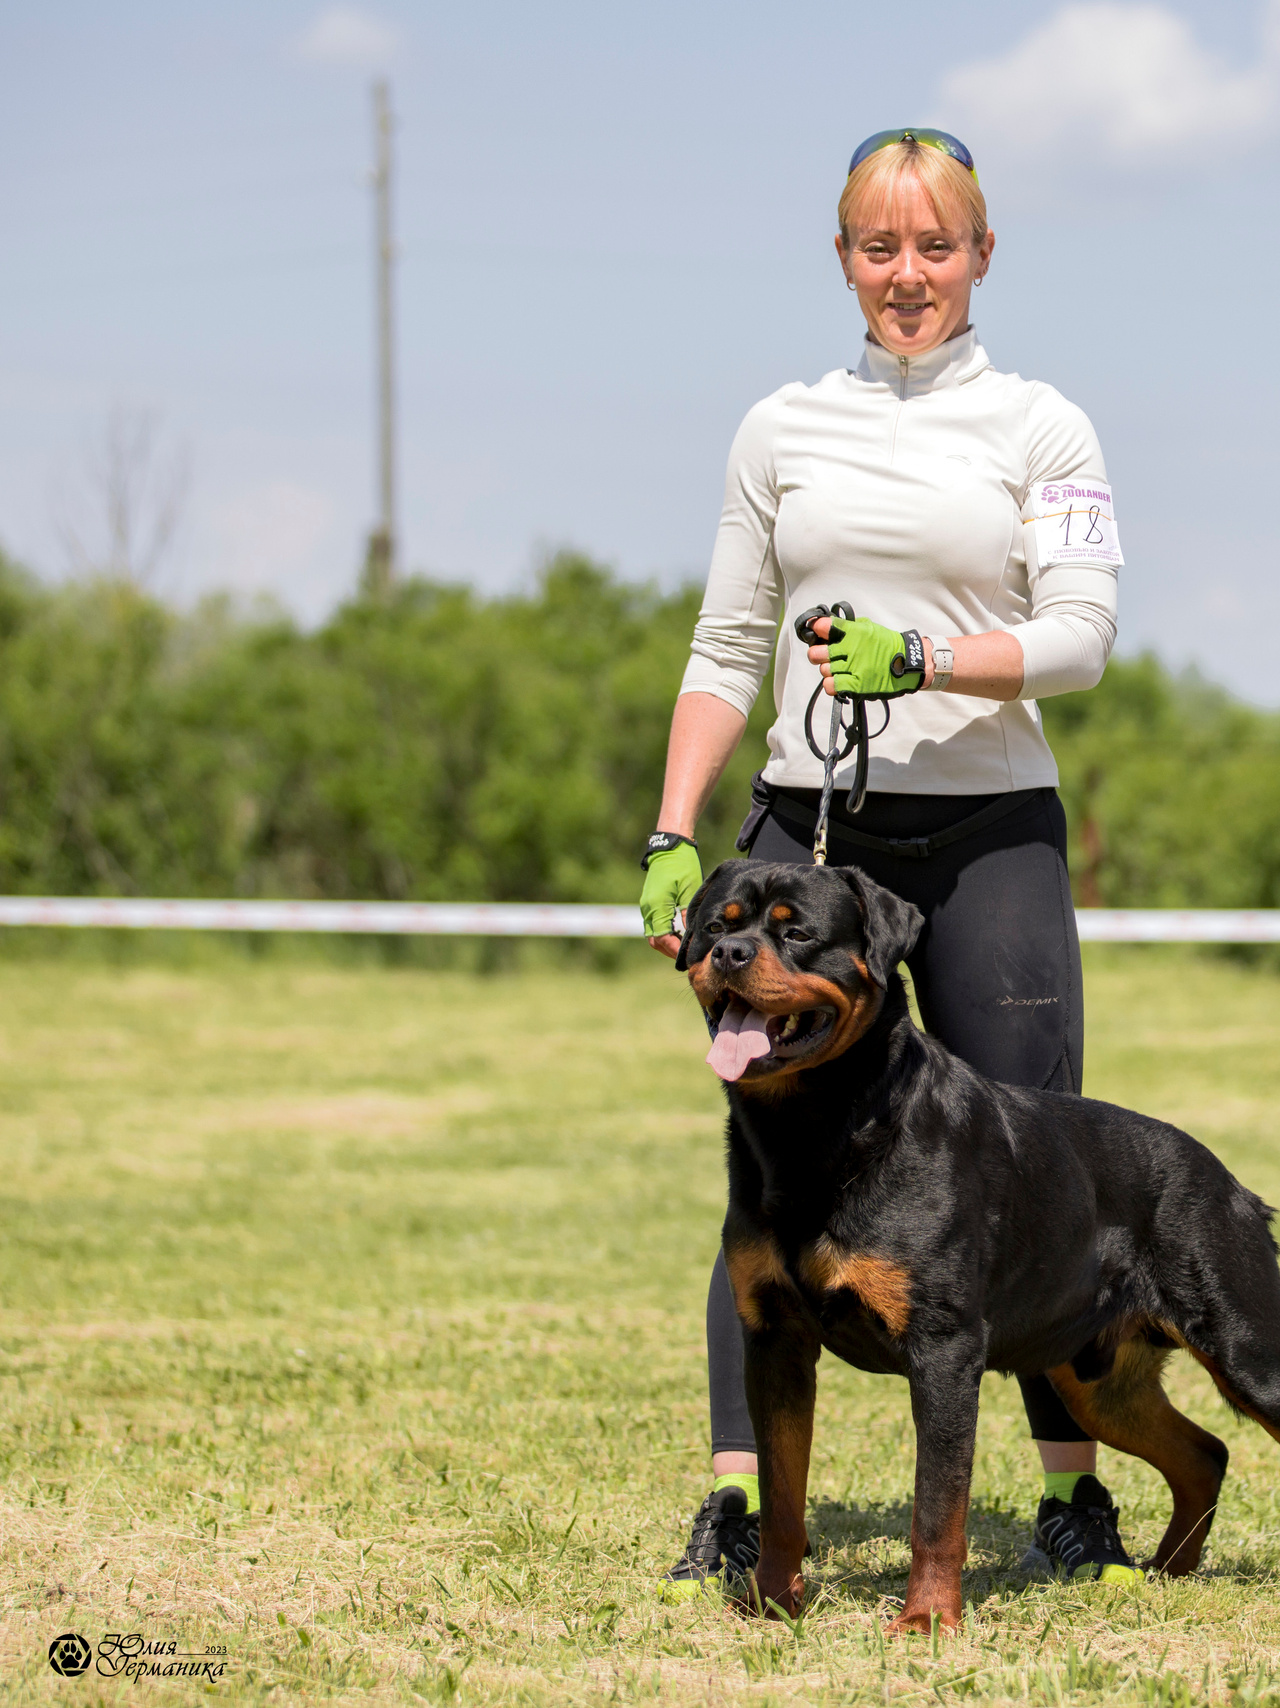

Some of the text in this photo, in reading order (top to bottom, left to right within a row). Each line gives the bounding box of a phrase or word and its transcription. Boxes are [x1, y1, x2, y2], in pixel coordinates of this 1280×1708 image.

[1062, 488, 1111, 503] ZOOLANDER
[1059, 504, 1104, 546] 18
[1014, 997, 1060, 1006] DEMIX
